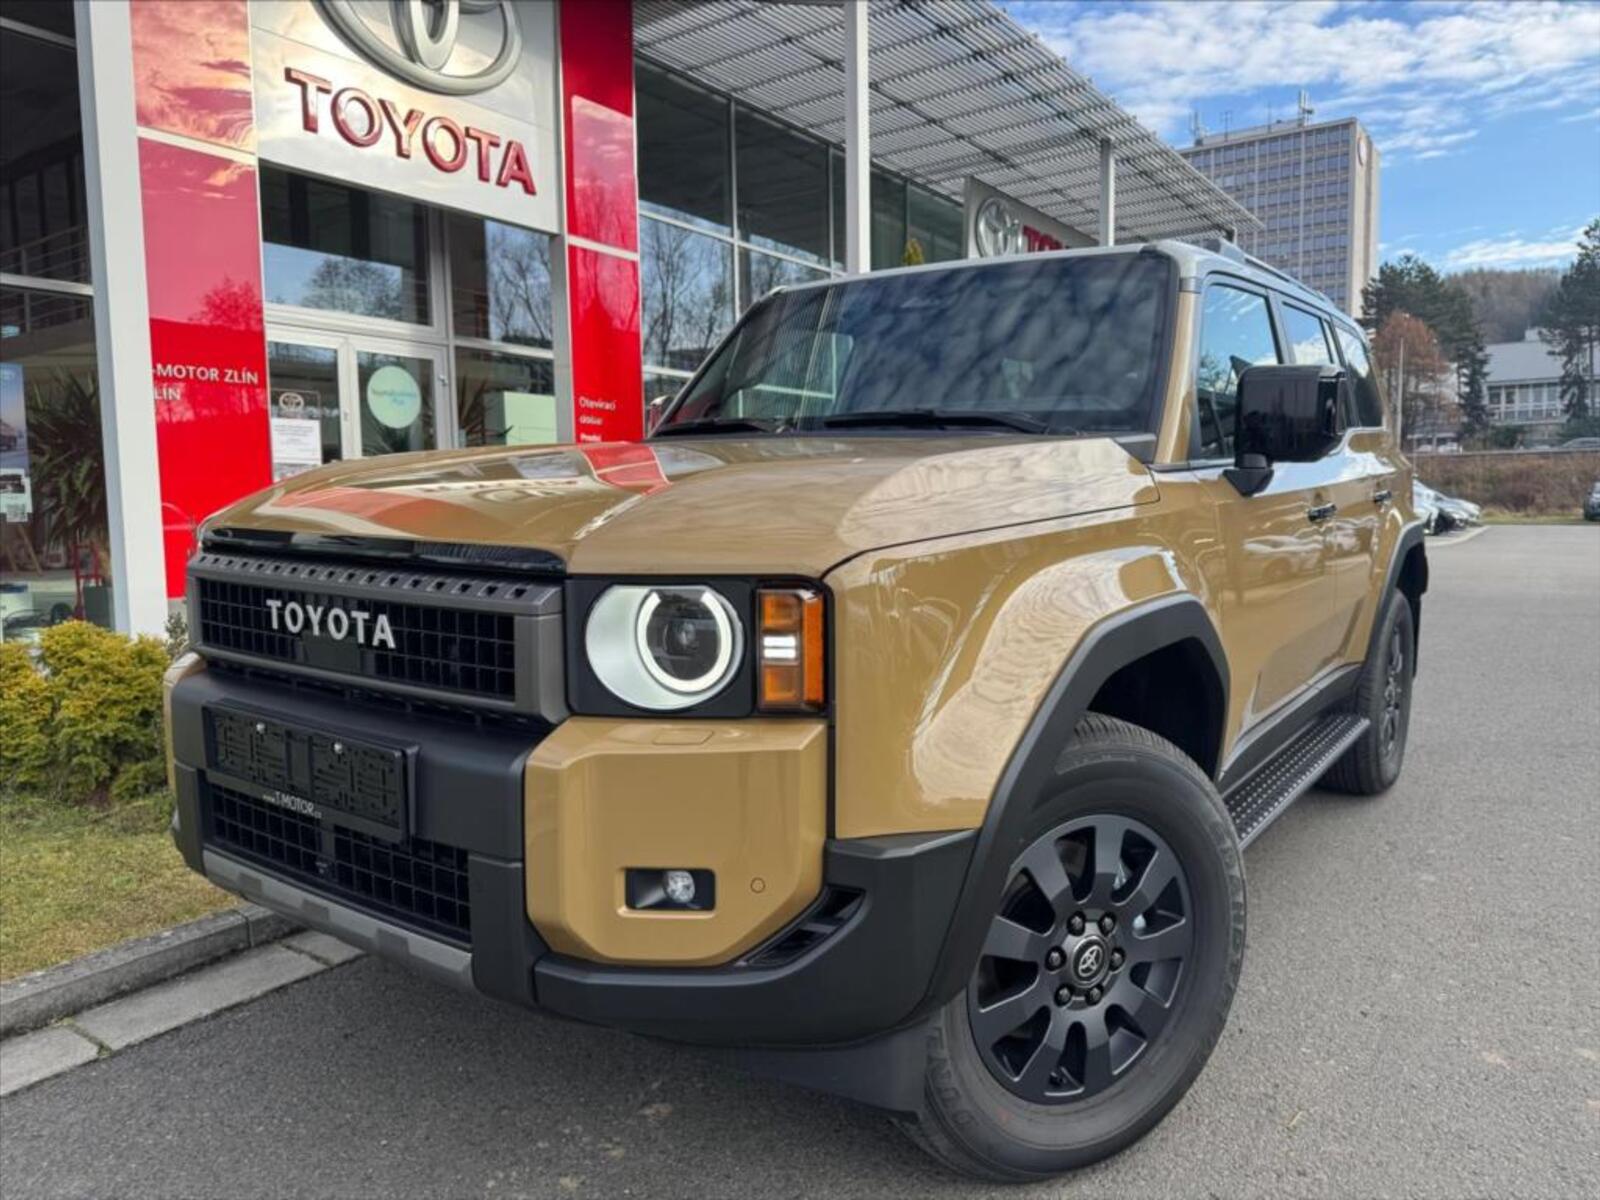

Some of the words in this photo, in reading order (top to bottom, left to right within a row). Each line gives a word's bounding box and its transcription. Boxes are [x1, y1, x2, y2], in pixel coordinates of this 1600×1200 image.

[284, 66, 537, 196] TOYOTA
[152, 363, 219, 381] -MOTOR
[224, 366, 259, 385] ZLÍN
[154, 382, 181, 401] LÍN
[266, 598, 396, 649] TOYOTA
